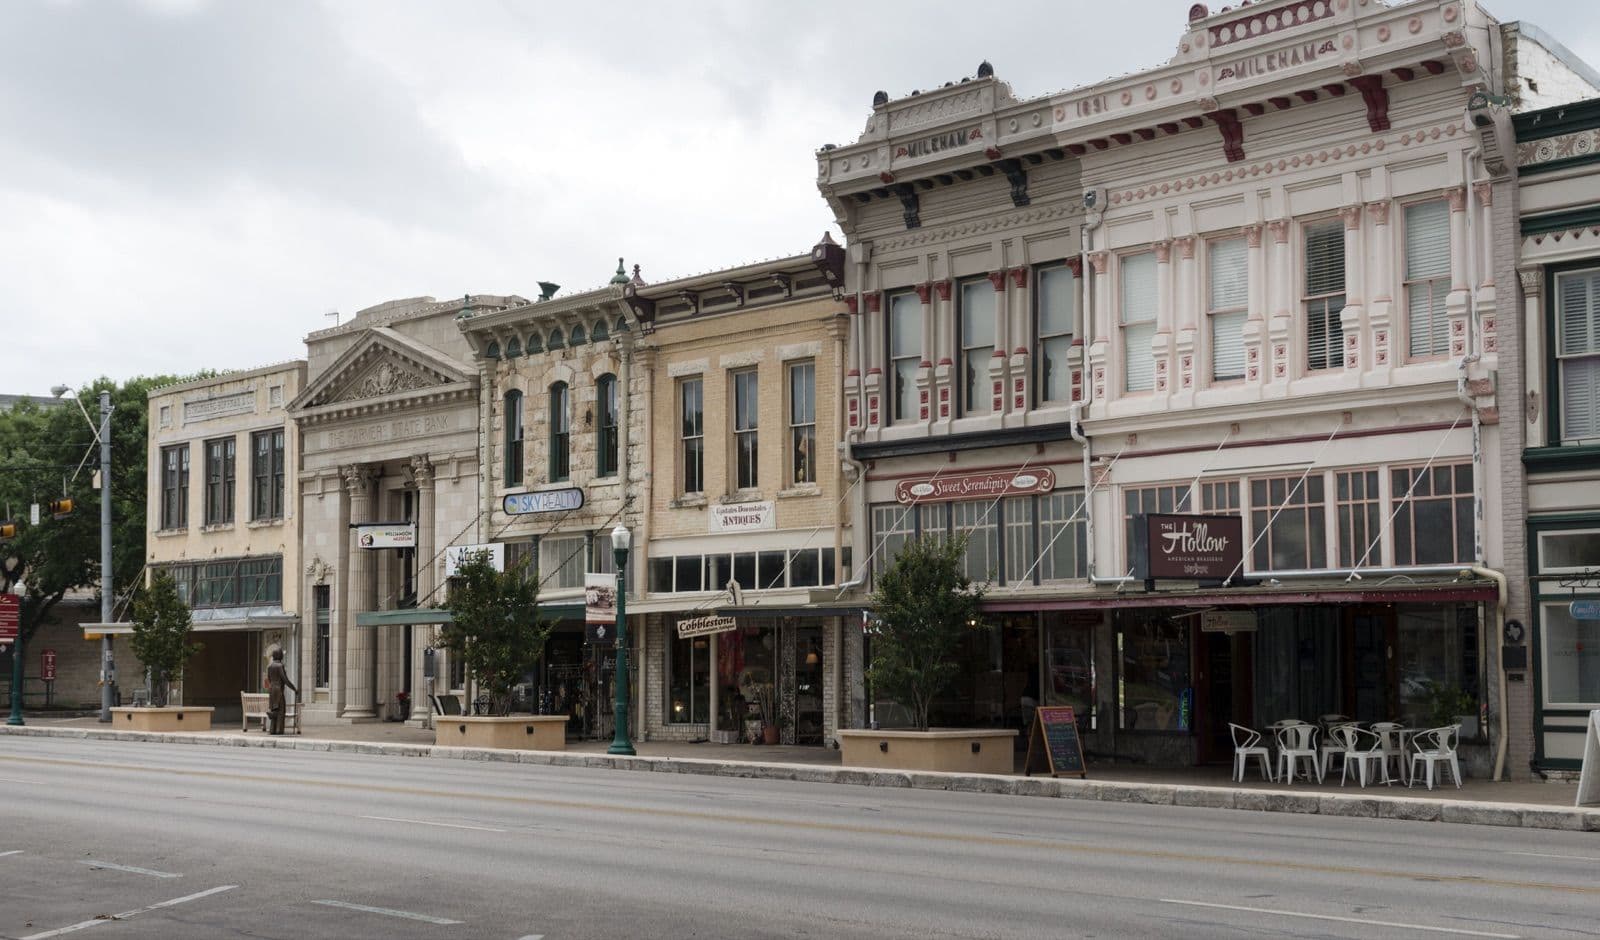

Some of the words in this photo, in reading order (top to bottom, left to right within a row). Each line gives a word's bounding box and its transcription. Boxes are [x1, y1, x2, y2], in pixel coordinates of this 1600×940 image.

[1234, 43, 1317, 80] MILEHAM
[1076, 95, 1108, 117] 1891
[908, 128, 967, 158] MILEHAM
[328, 429, 345, 447] THE
[392, 418, 421, 438] STATE
[424, 414, 448, 432] BANK
[934, 480, 960, 497] Sweet
[960, 475, 1010, 497] Serendipity
[522, 495, 541, 512] SKY
[542, 490, 578, 509] REALTY
[722, 513, 761, 527] ANTIQUES
[1162, 521, 1229, 554] Hollow
[680, 616, 734, 632] Cobblestone
